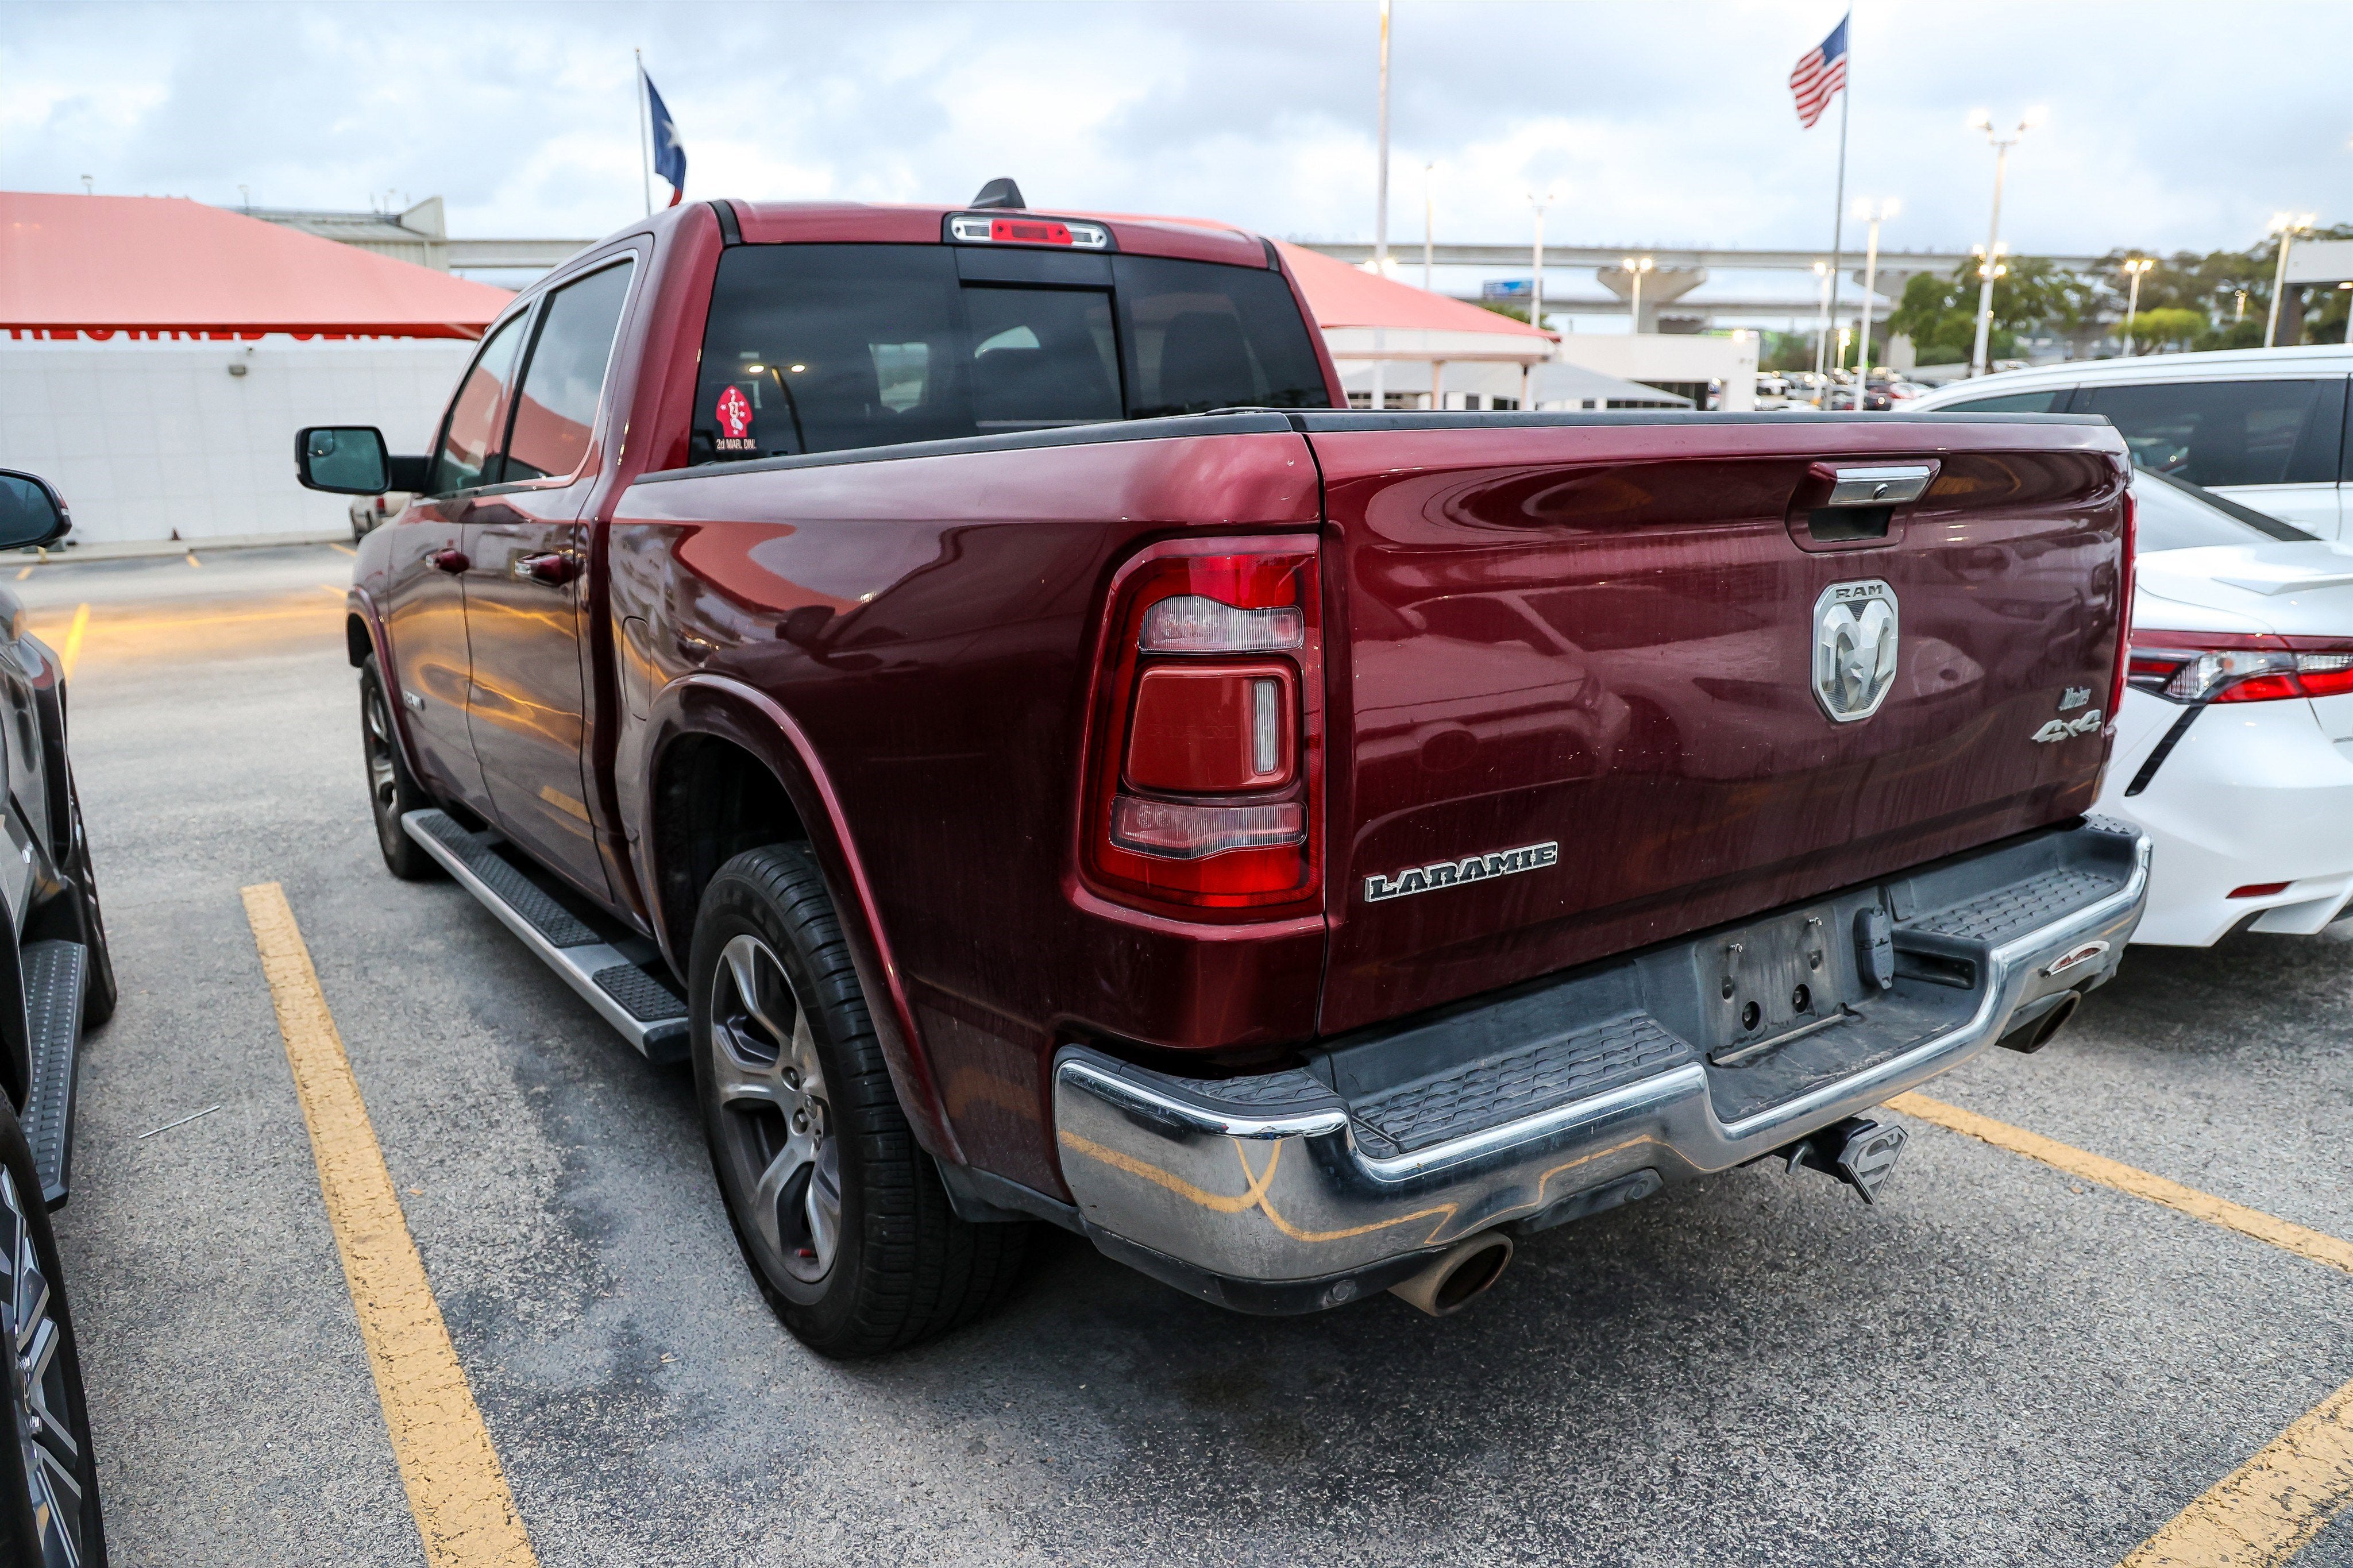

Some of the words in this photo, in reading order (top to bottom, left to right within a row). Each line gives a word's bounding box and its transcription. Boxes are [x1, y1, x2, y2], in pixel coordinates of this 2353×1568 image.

[716, 438, 725, 450] 2d
[726, 438, 743, 450] MAR.
[744, 438, 757, 450] DIV.
[1836, 585, 1883, 598] RAM
[1364, 841, 1557, 902] LARAMIE
